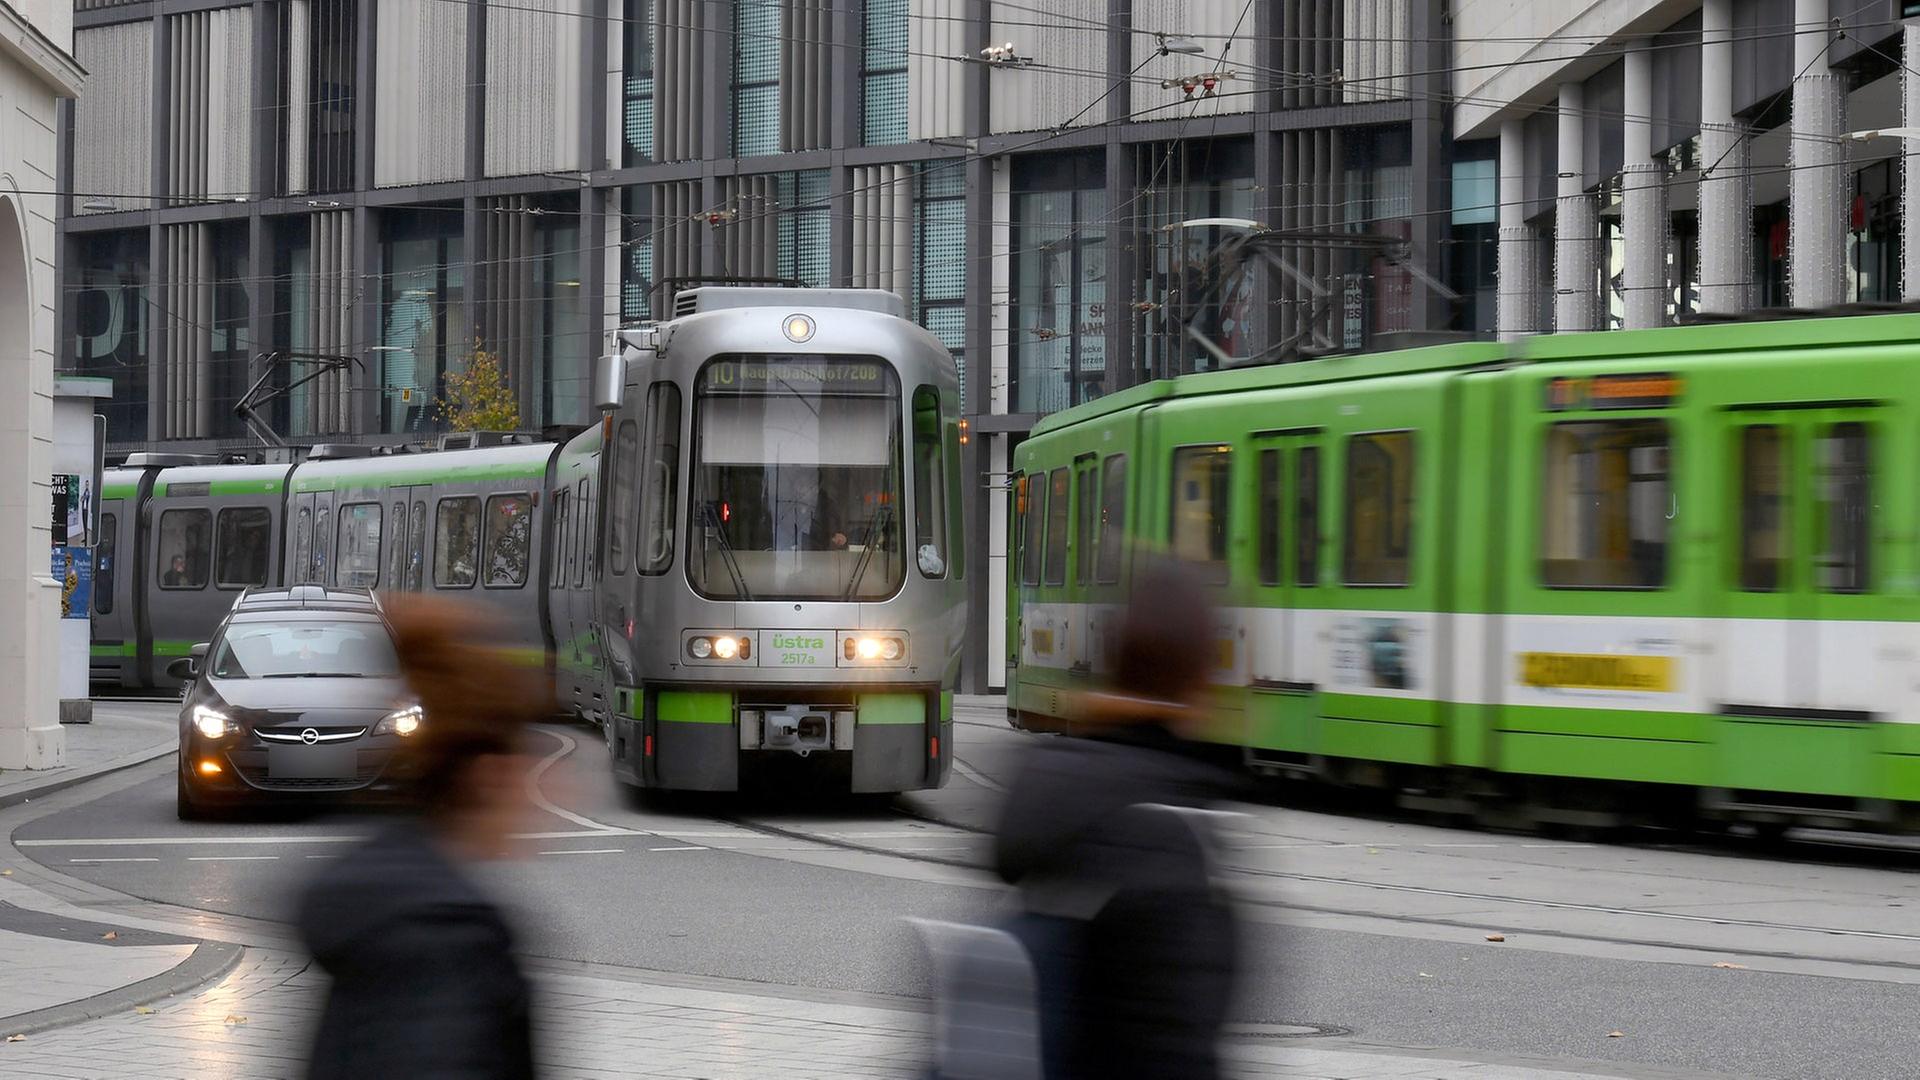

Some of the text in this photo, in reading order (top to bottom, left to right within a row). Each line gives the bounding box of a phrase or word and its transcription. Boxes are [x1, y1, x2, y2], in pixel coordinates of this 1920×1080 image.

[713, 362, 733, 384] 10
[773, 633, 824, 649] üstra
[782, 653, 816, 665] 2517a
